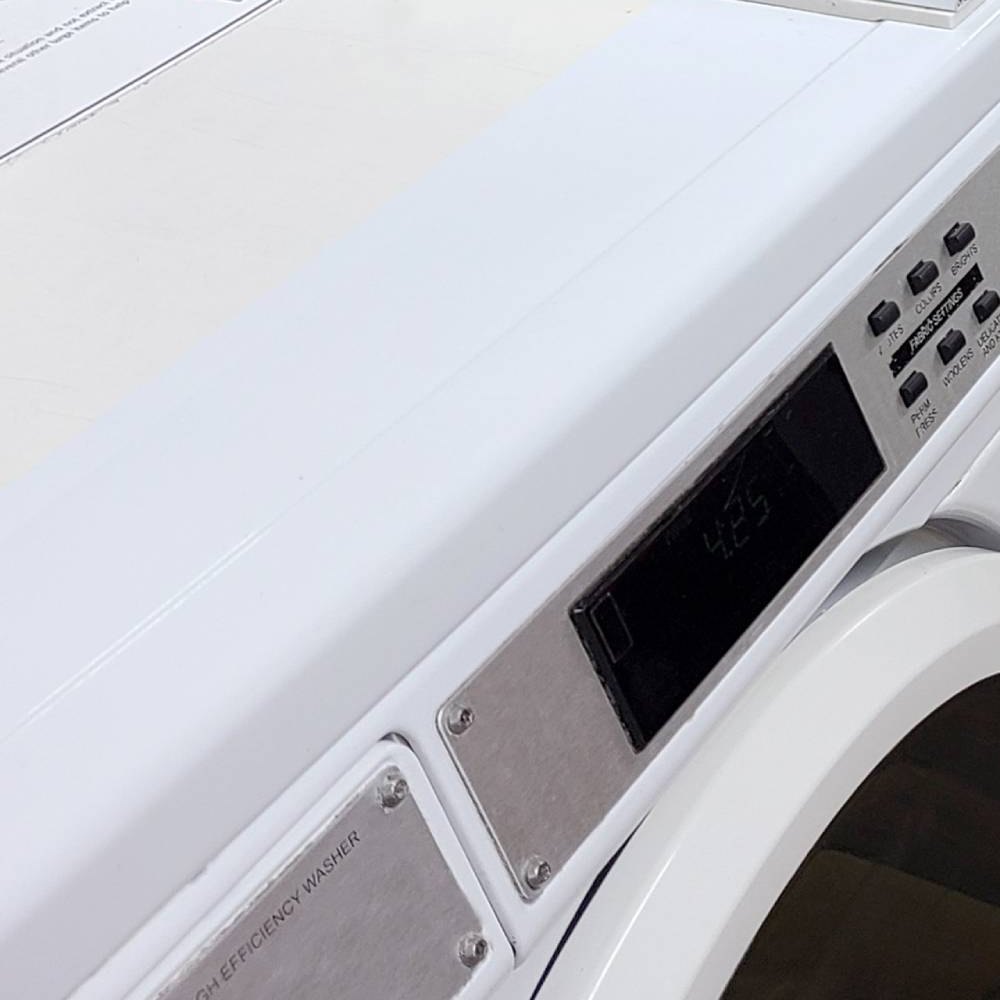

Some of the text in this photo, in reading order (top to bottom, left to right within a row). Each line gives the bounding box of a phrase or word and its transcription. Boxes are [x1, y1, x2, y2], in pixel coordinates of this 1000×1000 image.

[951, 243, 978, 276] BRIGHTS
[910, 287, 964, 352] FABRIC SETTINGS
[943, 347, 974, 387] WOOLENS
[196, 830, 361, 1000] GH EFFICIENCY WASHER
